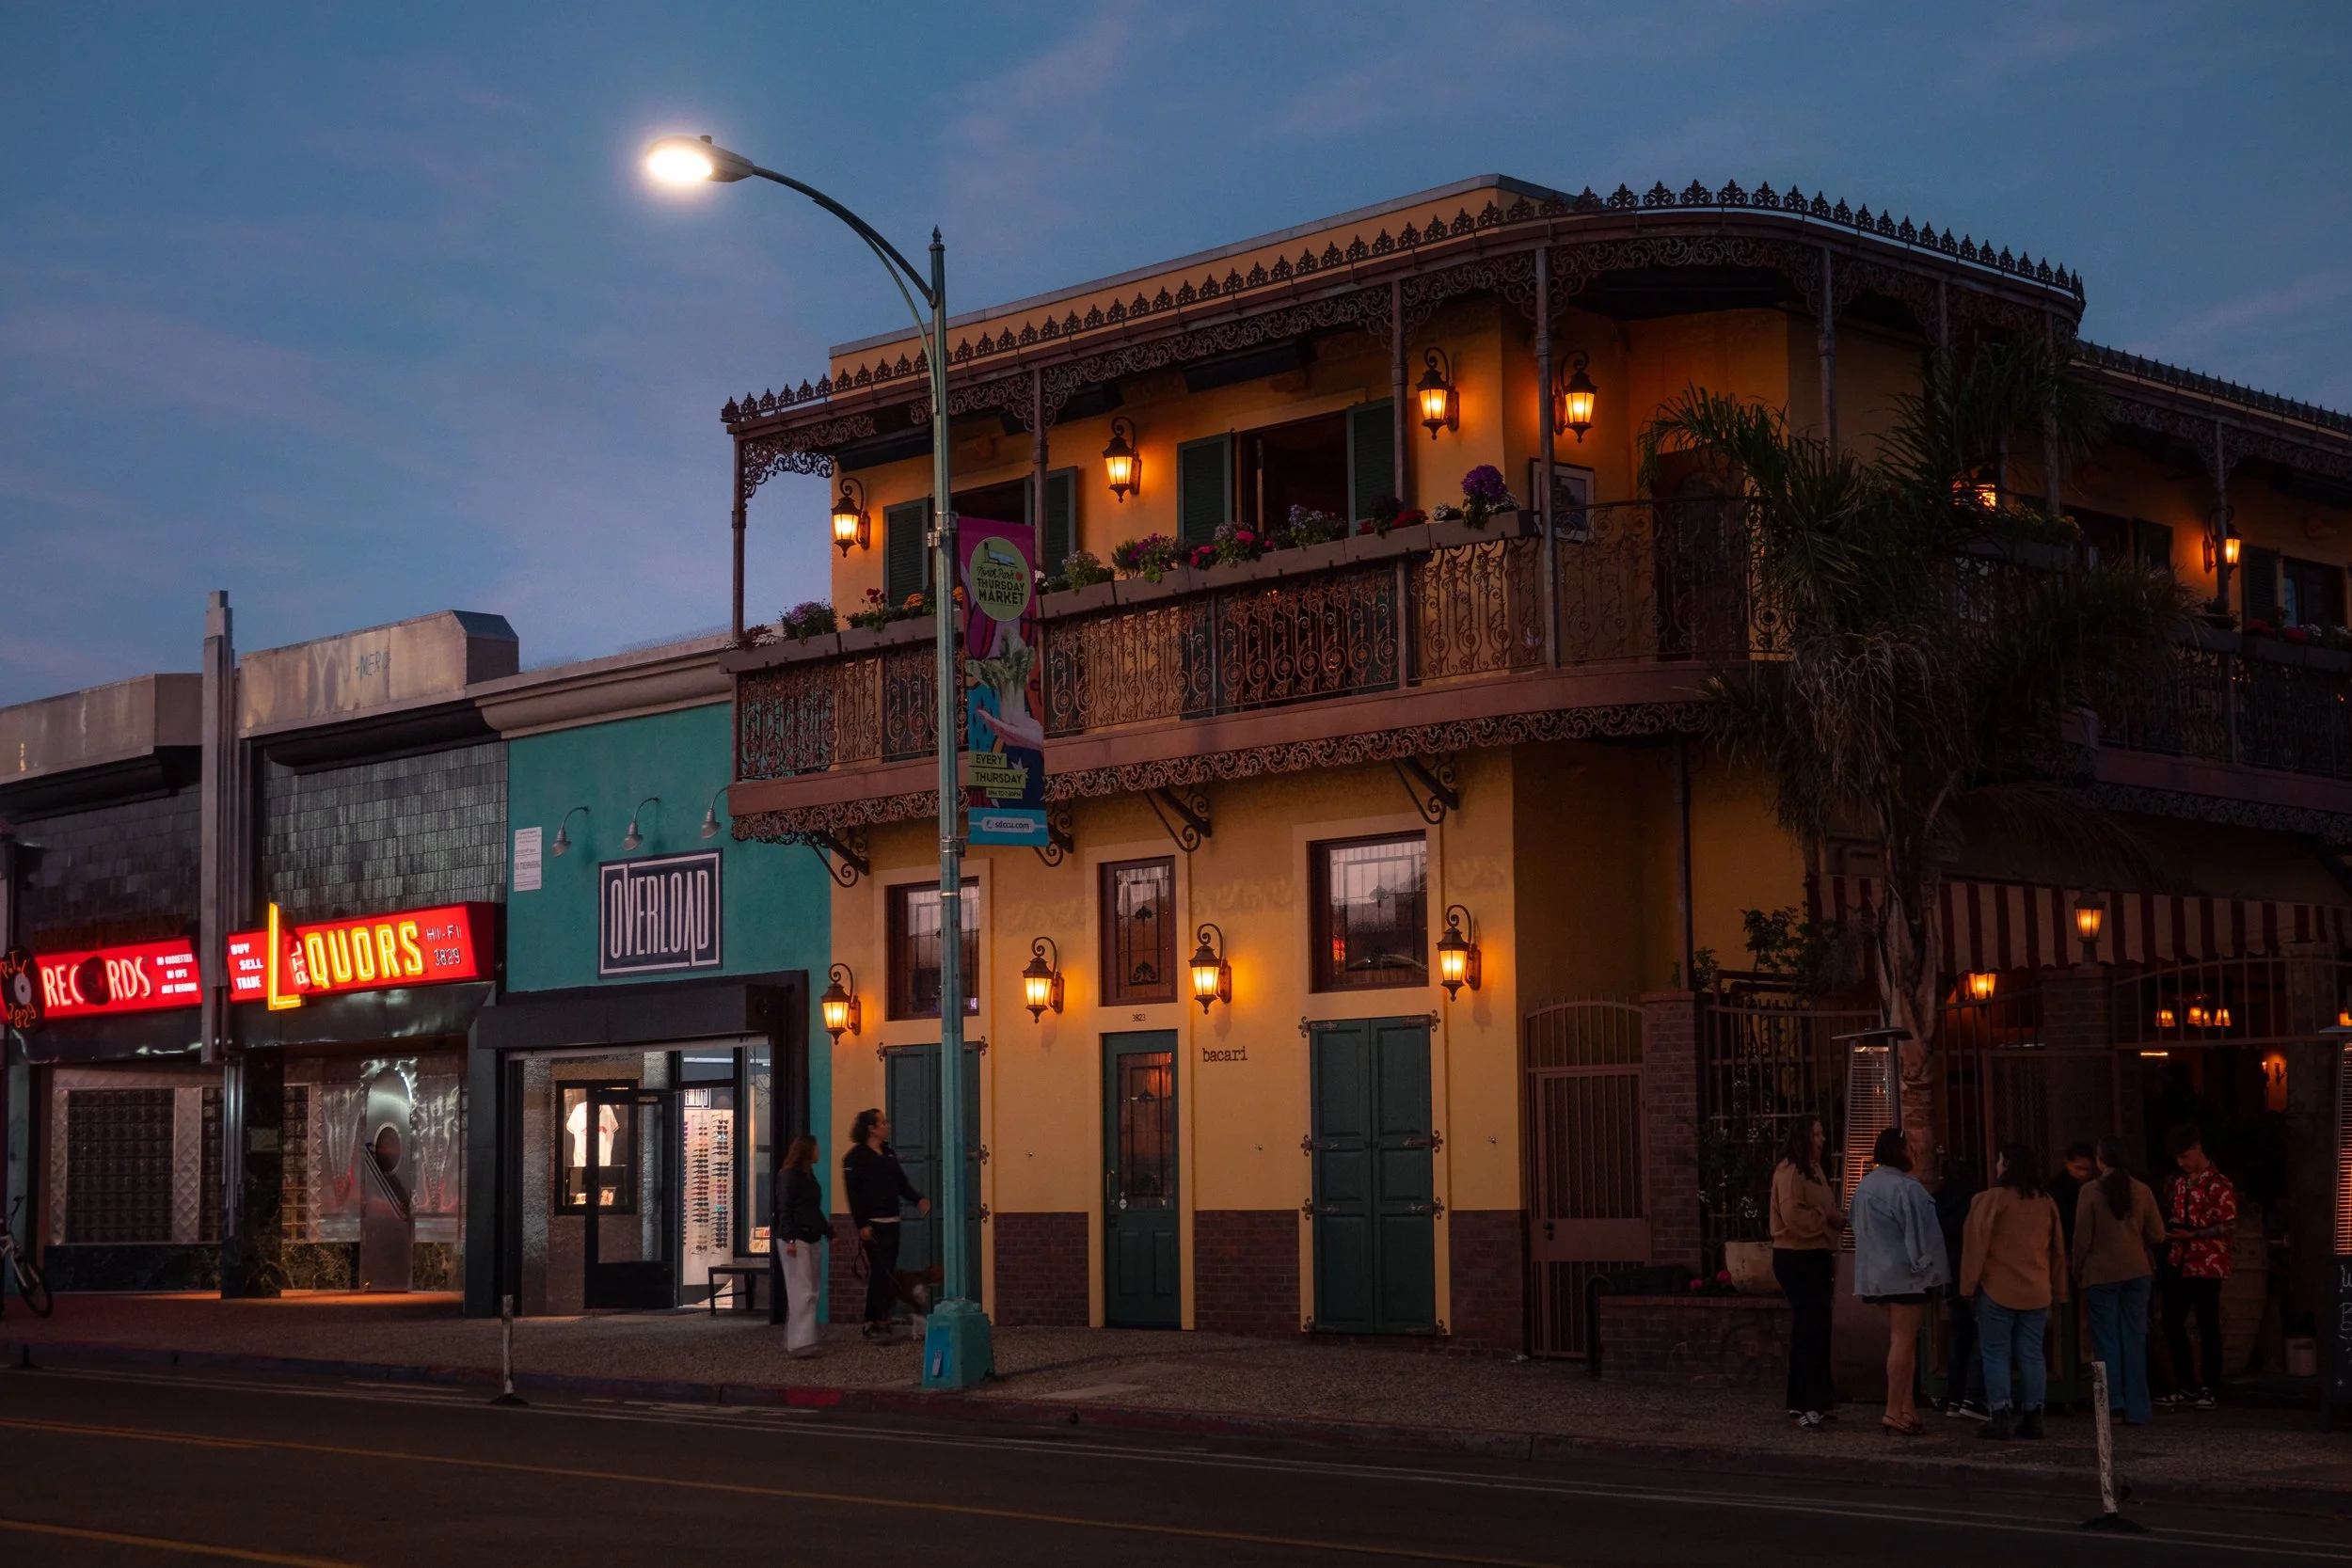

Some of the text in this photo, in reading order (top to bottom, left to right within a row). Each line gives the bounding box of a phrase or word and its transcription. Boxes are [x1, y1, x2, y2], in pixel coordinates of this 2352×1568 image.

[977, 578, 1025, 592] THURSDAY
[978, 589, 1025, 605] MARKET
[976, 753, 1003, 765] EVERY
[975, 771, 1023, 784] THURSDAY
[994, 820, 1029, 830] sdccu.com
[610, 869, 709, 959] OVERLOAD
[426, 925, 461, 942] HI-FI
[230, 942, 249, 956] BUY
[433, 947, 461, 966] 3829
[240, 958, 263, 971] SELL
[41, 956, 151, 1008] RECORDS
[236, 975, 262, 990] TRADE
[7, 1002, 39, 1030] 3829
[1132, 1013, 1146, 1022] 3823
[1202, 1045, 1248, 1063] bacari
